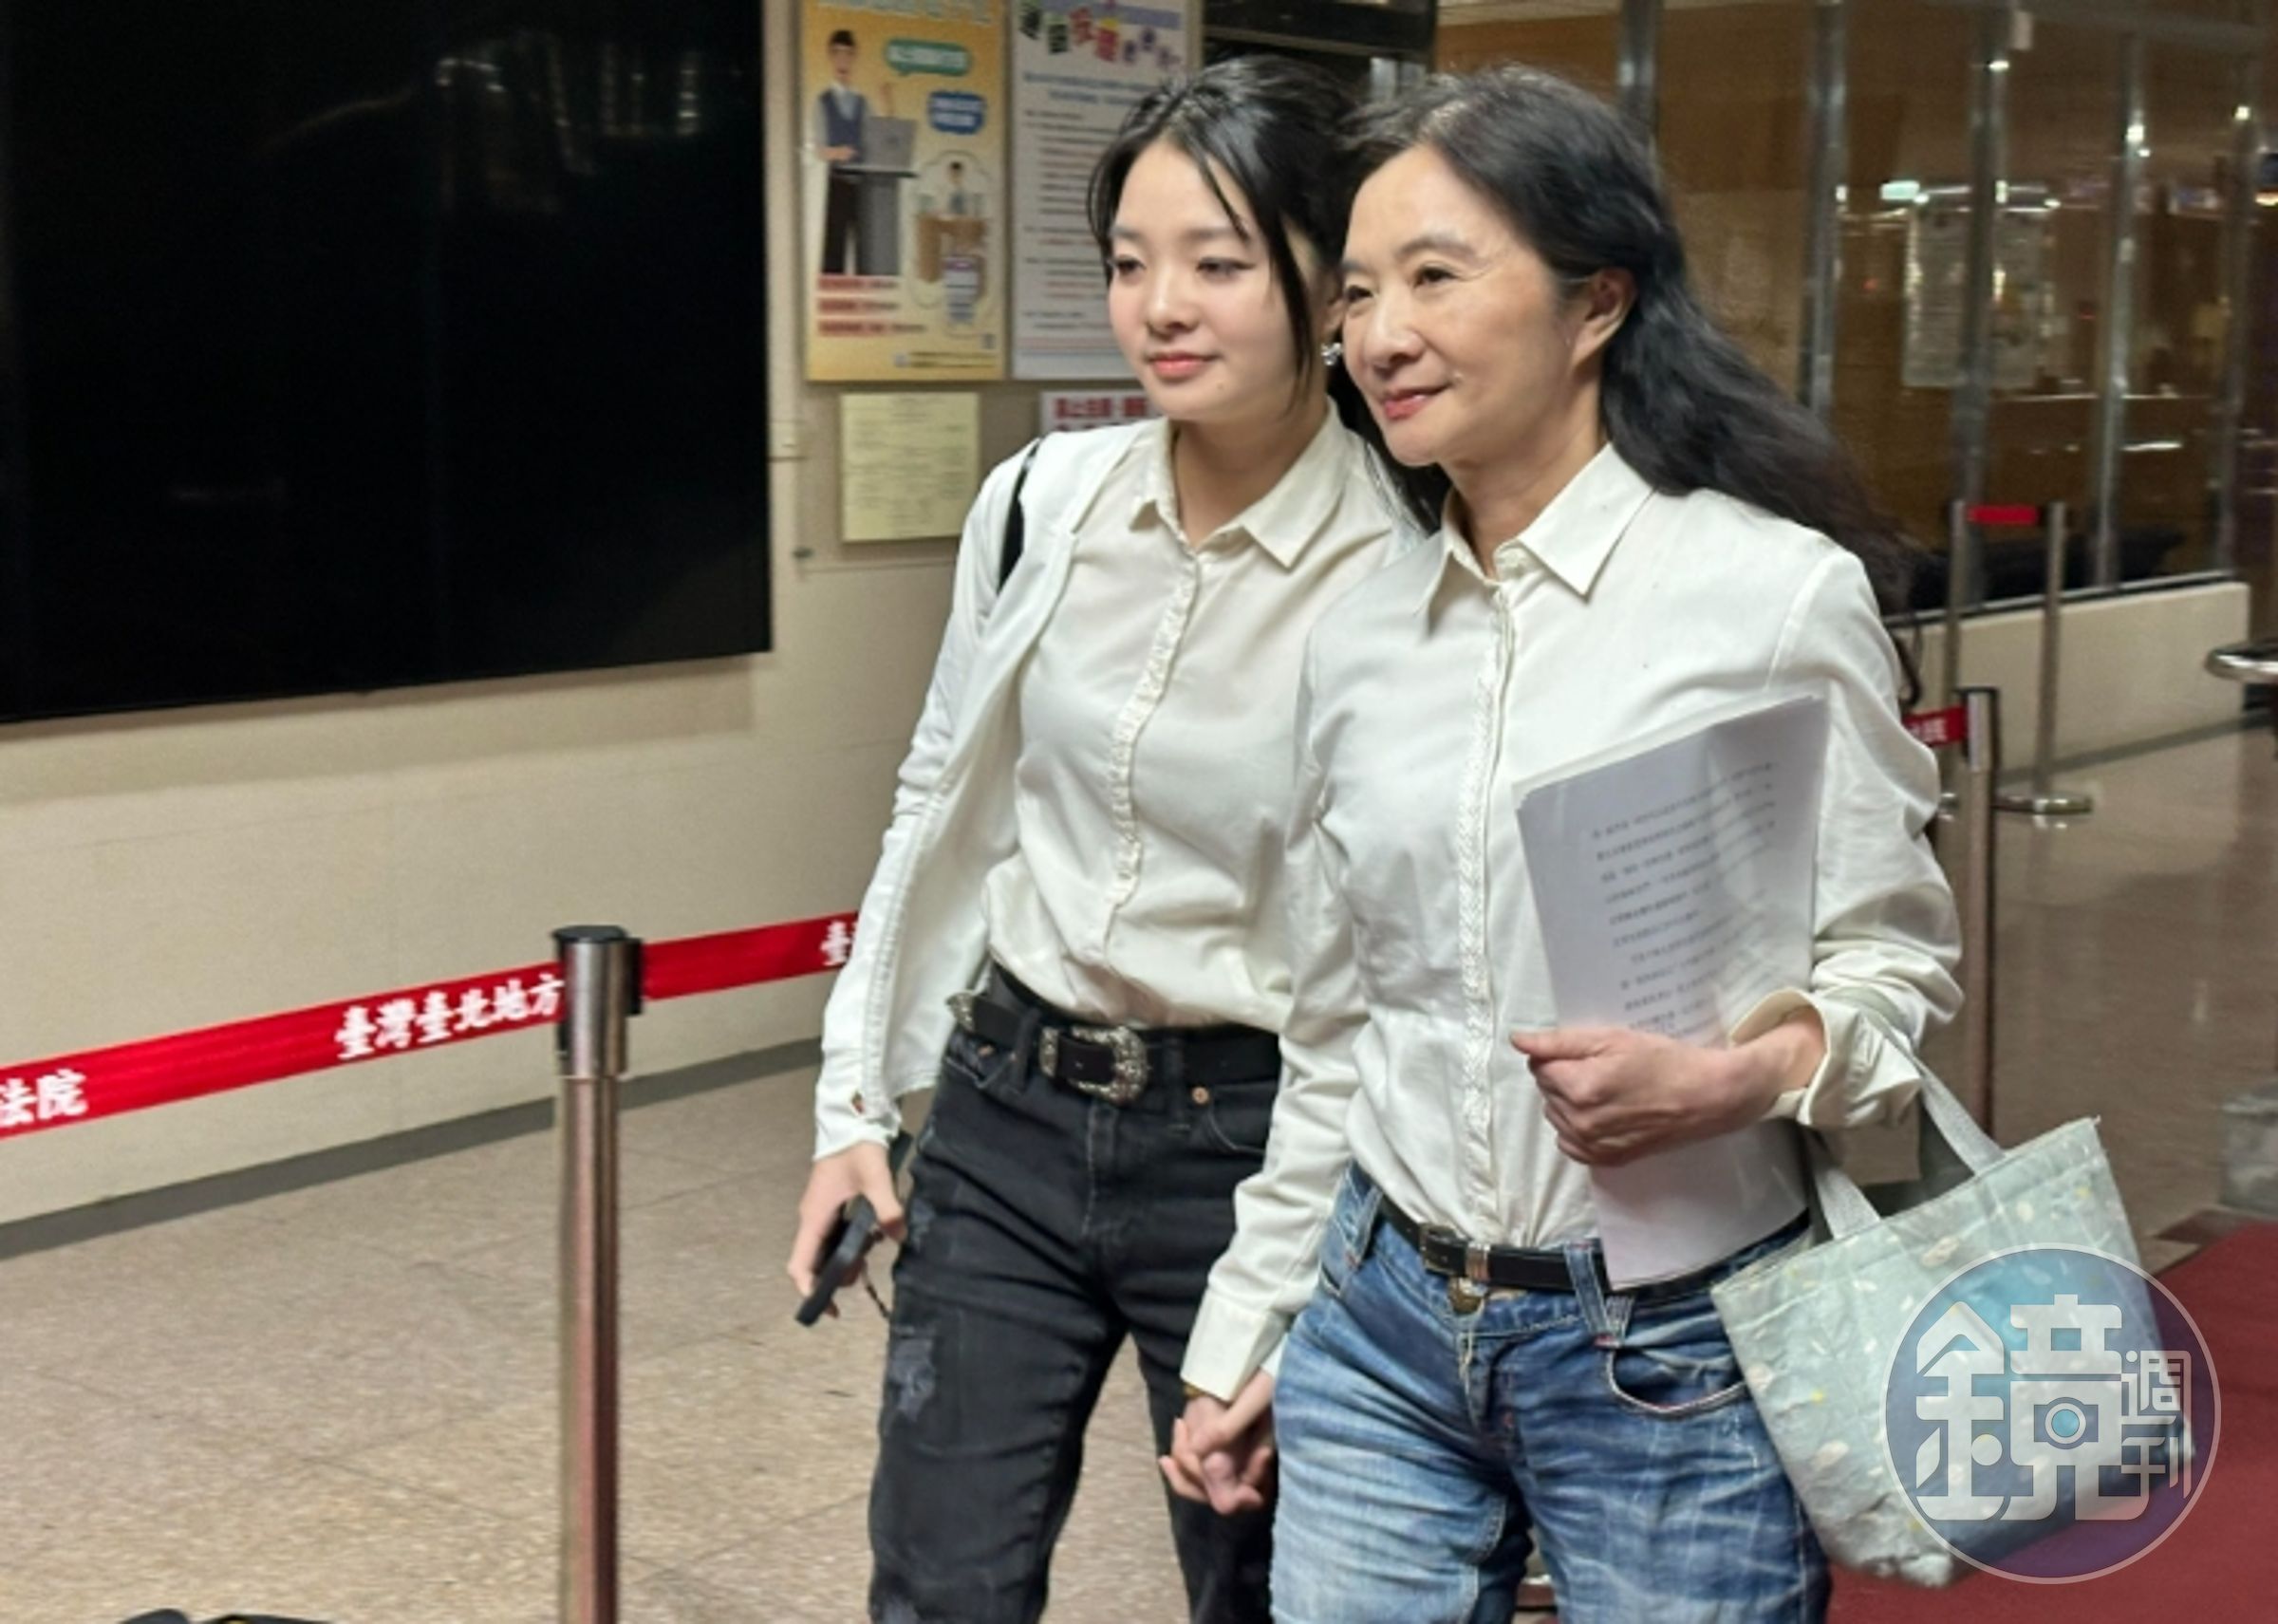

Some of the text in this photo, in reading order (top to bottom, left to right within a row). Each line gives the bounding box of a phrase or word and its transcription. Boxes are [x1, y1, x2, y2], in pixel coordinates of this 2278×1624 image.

[820, 920, 858, 966] 臺
[334, 973, 565, 1060] 臺灣臺北地方
[0, 1068, 89, 1128] 法院
